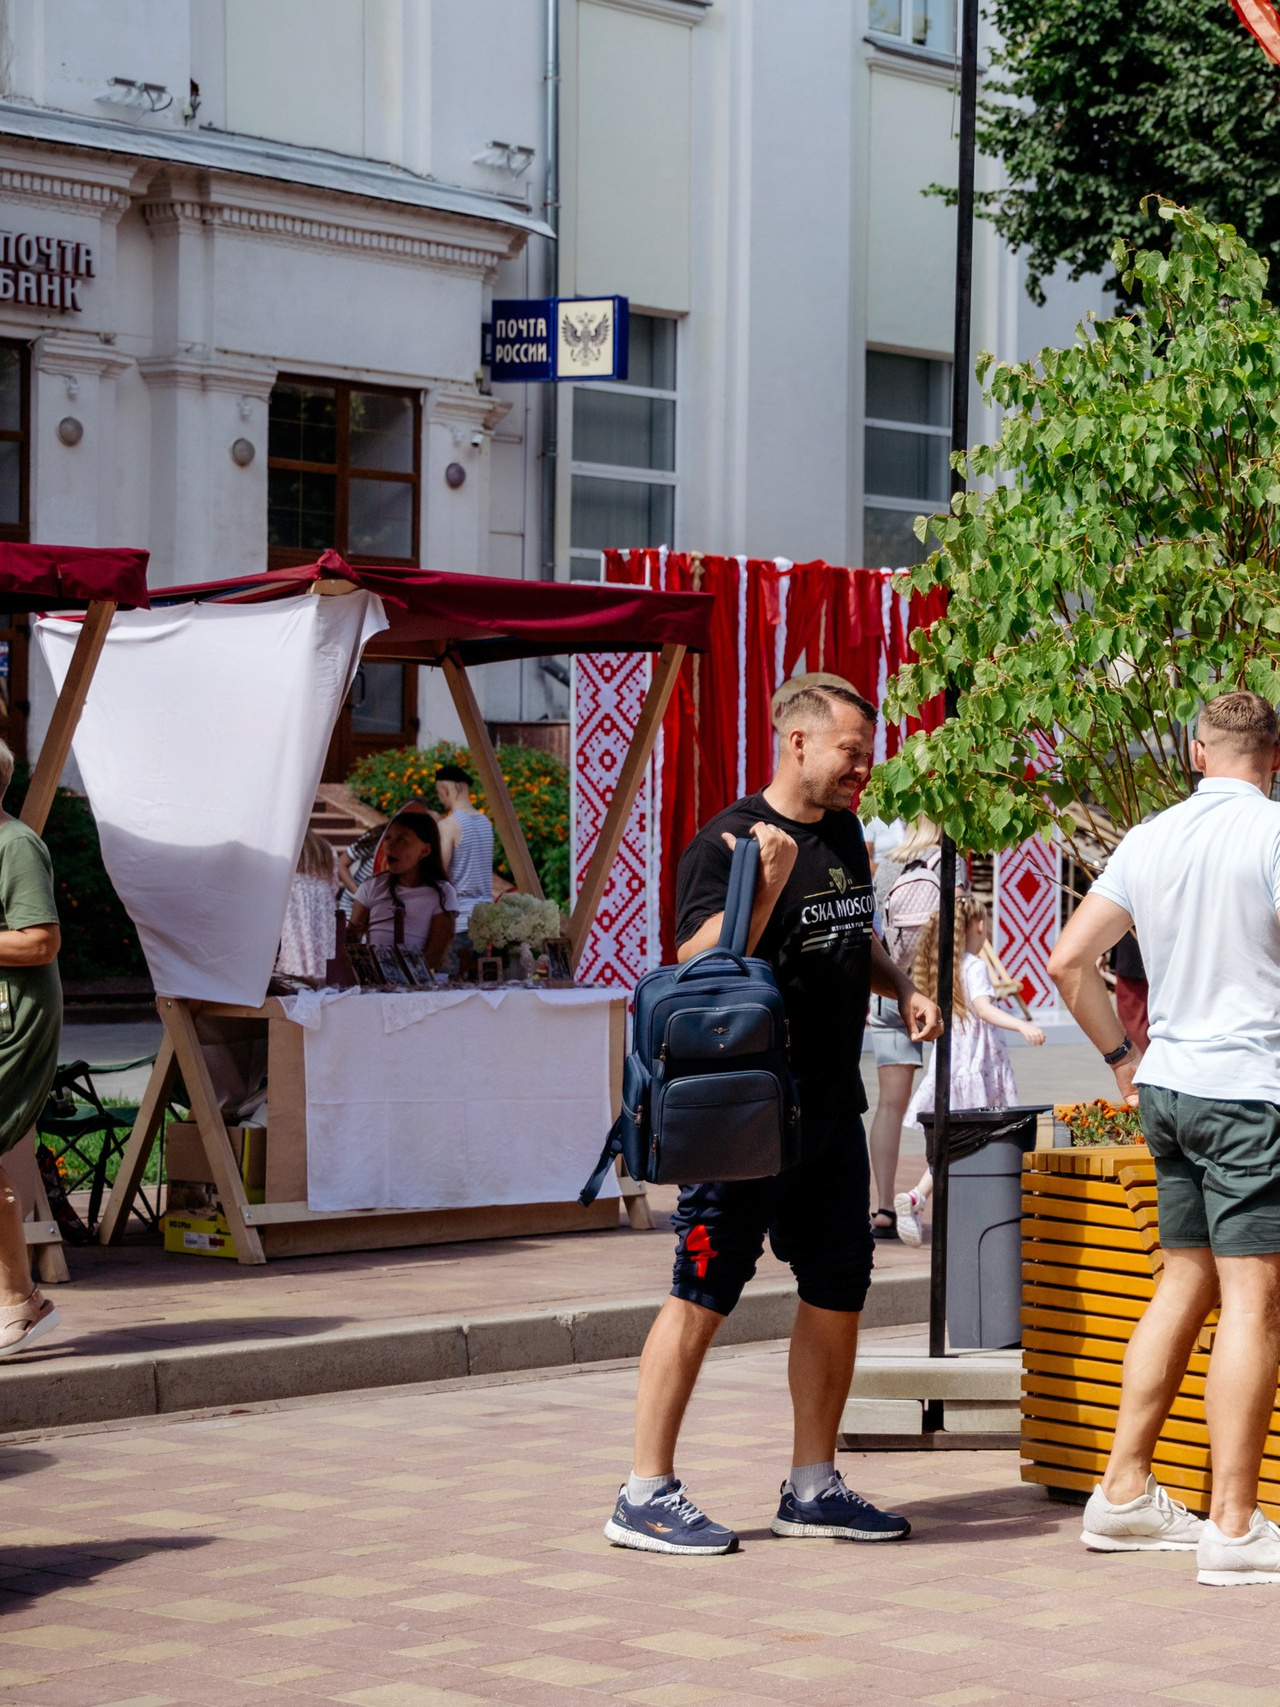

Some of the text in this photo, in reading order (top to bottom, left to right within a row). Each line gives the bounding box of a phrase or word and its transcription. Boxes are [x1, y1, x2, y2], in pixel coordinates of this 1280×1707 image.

[0, 231, 96, 278] ПОЧТА
[0, 267, 82, 312] БАНК
[496, 317, 547, 338] ПОЧТА
[495, 343, 547, 363] РОССИИ
[802, 902, 836, 924] CSKA
[792, 1525, 819, 1535] PILOT
